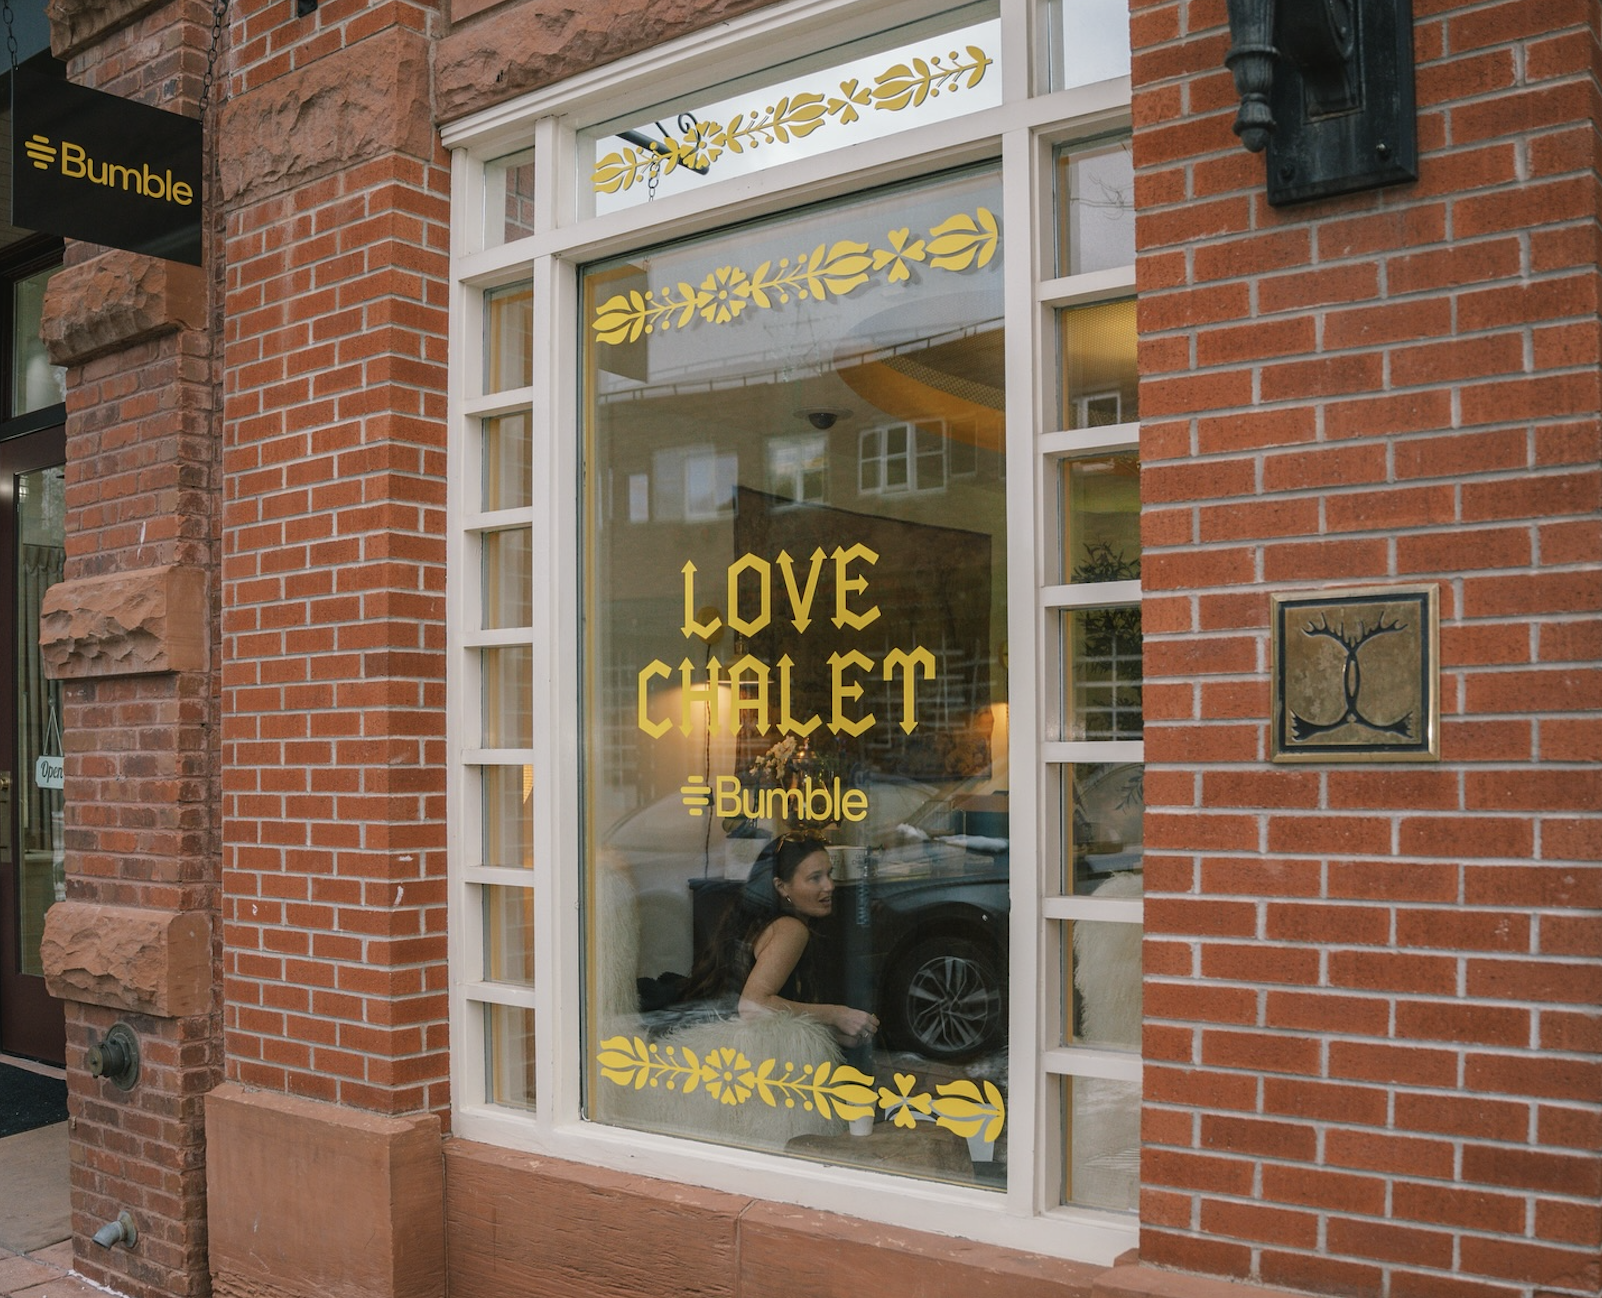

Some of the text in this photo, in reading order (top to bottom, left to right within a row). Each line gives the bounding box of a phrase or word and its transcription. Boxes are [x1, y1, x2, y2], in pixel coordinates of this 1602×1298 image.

[61, 141, 193, 206] Bumble
[680, 542, 882, 639] LOVE
[638, 645, 936, 739] CHALET
[41, 760, 63, 783] Open
[716, 775, 868, 822] Bumble
